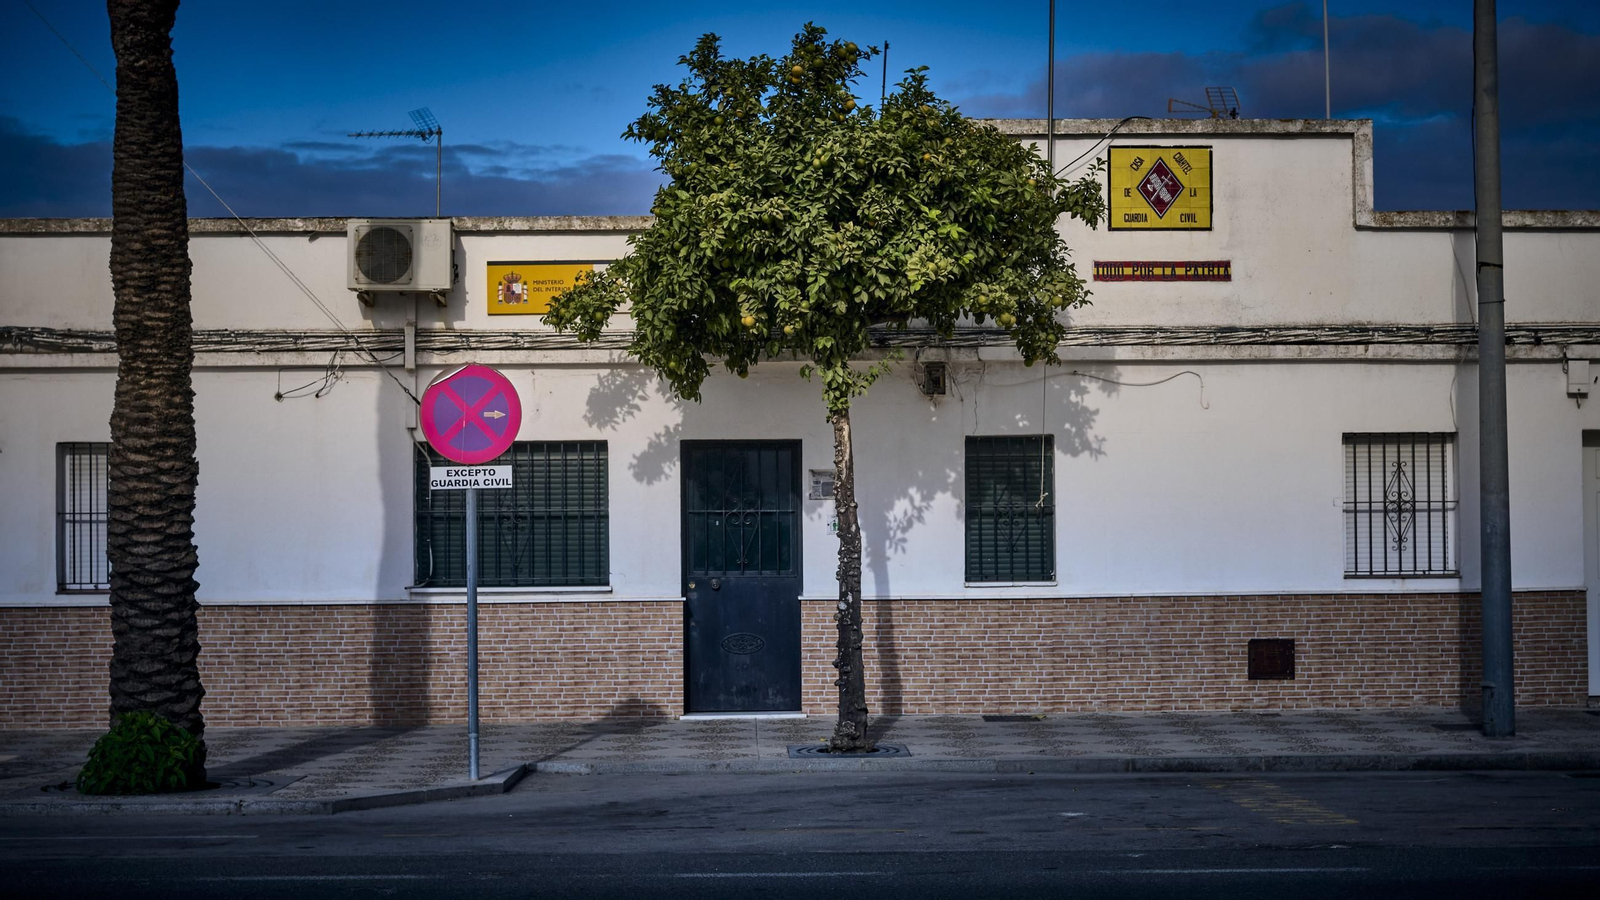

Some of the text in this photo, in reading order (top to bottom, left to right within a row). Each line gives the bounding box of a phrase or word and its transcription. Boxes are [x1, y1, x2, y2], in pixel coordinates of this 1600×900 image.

[1130, 152, 1194, 176] CASA CUARTEL
[1124, 188, 1197, 198] DE LA
[1124, 213, 1198, 223] GUARDIA CIVIL
[1094, 263, 1230, 280] TODO POR LA PATRIA
[446, 469, 496, 477] EXCEPTO
[431, 479, 480, 487] GUARDIA
